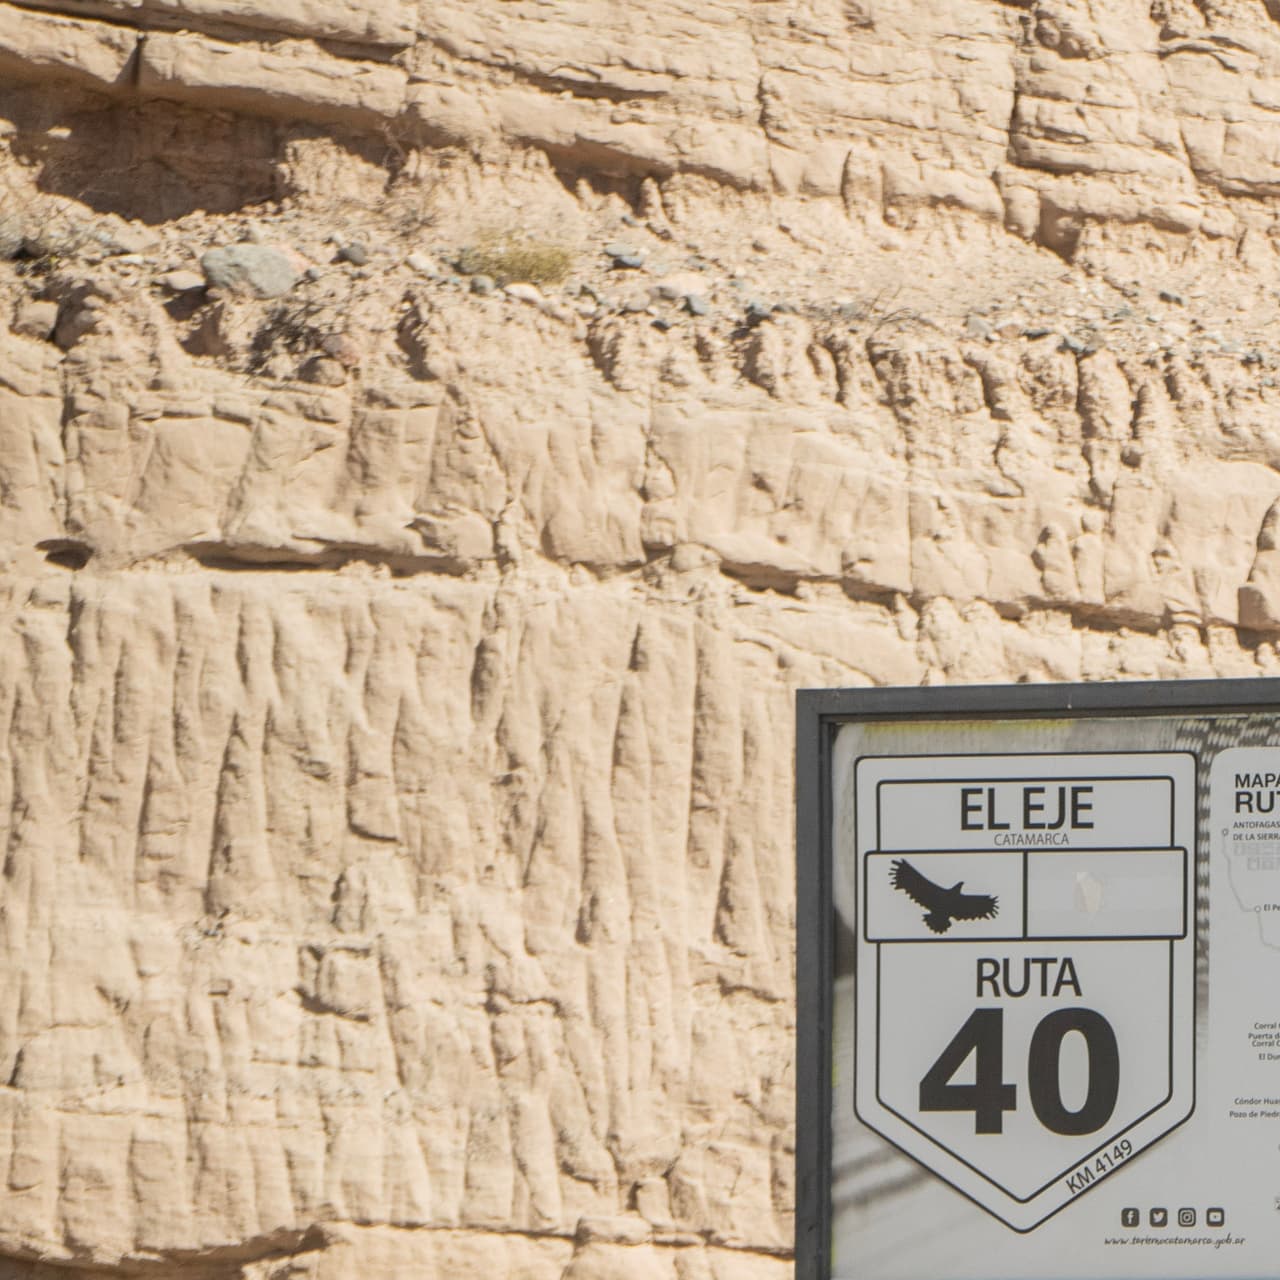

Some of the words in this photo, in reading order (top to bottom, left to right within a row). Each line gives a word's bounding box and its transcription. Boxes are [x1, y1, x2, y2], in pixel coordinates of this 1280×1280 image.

[960, 786, 1011, 831] EL
[1022, 785, 1095, 830] EJE
[993, 832, 1070, 847] CATAMARCA
[1233, 833, 1243, 841] DE
[1245, 833, 1255, 841] LA
[975, 957, 1083, 997] RUTA
[918, 1007, 1120, 1136] 40
[1234, 1097, 1262, 1105] Cóndor
[1065, 1166, 1096, 1194] KM
[1096, 1139, 1133, 1173] 4149
